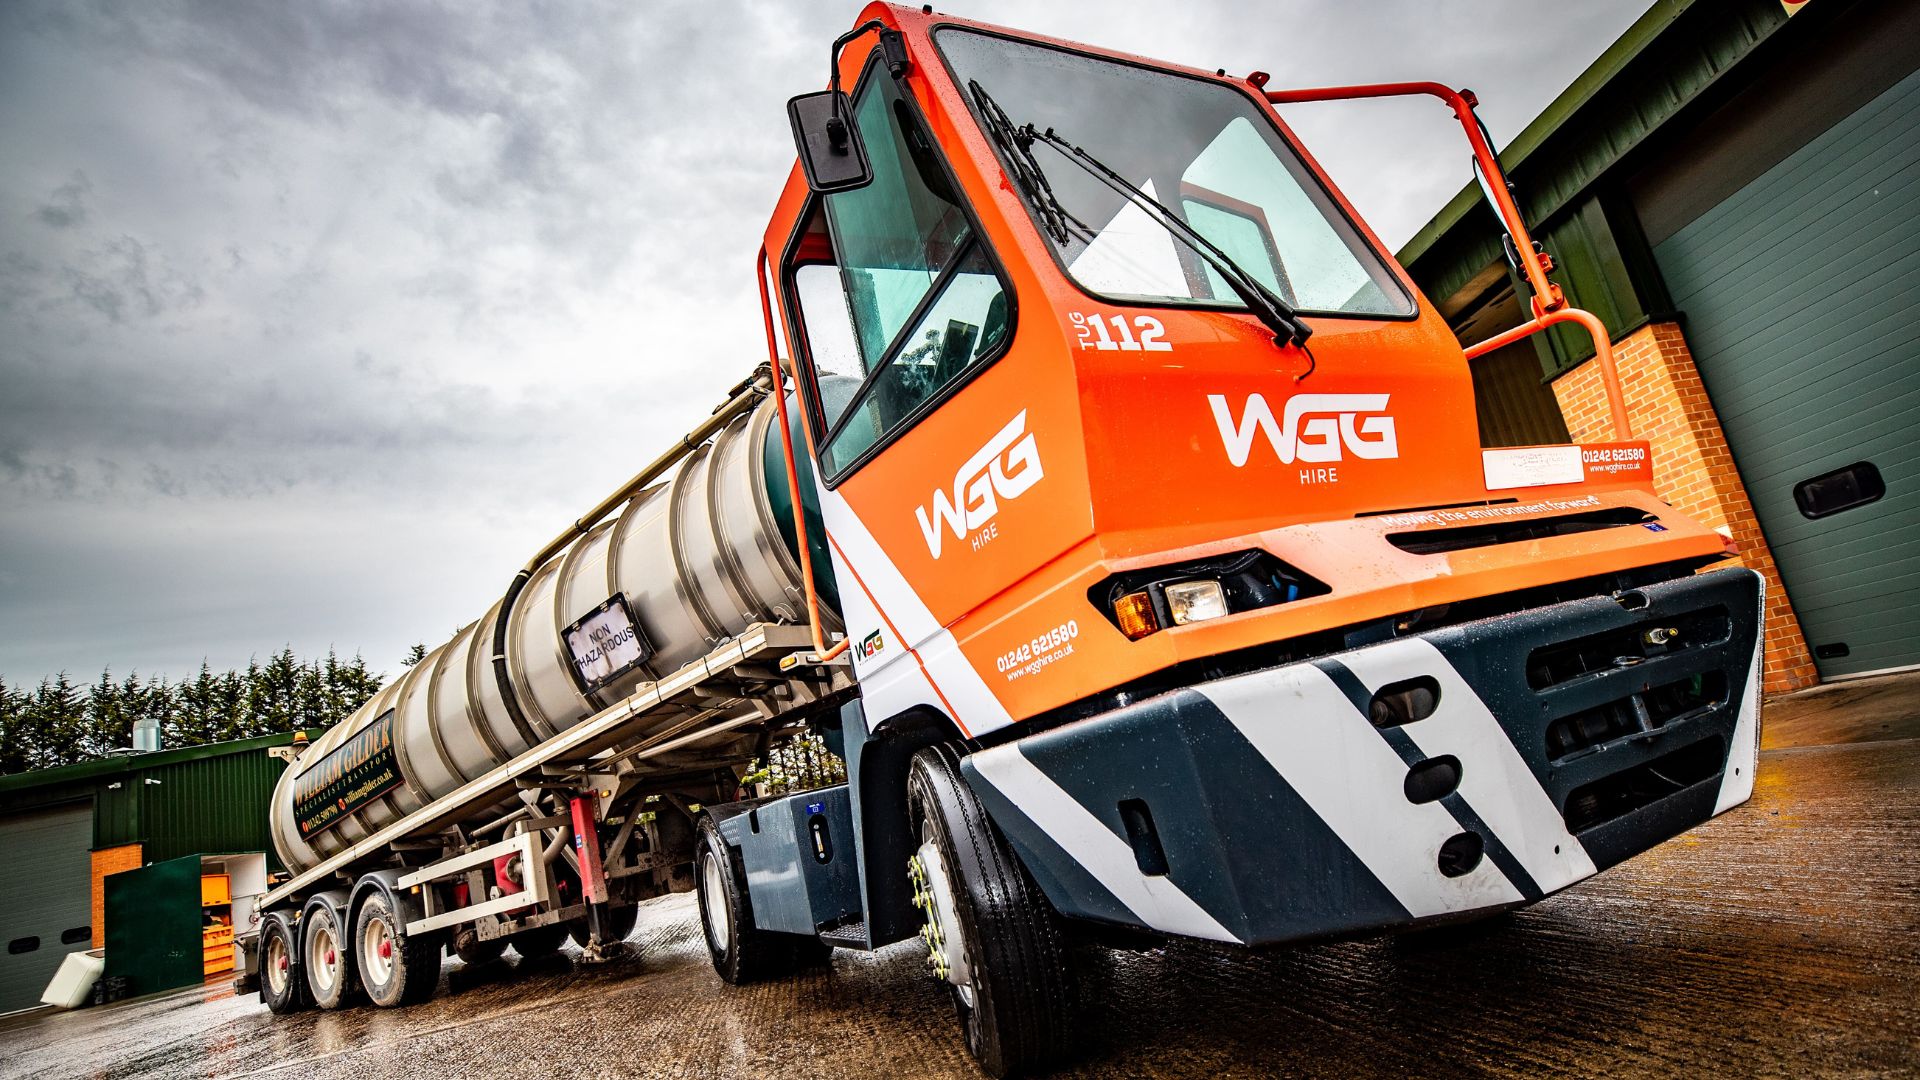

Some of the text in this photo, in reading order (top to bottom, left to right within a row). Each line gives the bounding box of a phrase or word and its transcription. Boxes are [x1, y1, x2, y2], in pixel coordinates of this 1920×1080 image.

[1069, 312, 1095, 350] TUG
[1086, 313, 1173, 351] 112
[1207, 393, 1399, 468] WGG
[1582, 448, 1645, 462] 01242 621580
[1590, 461, 1641, 474] www.wgghire.co.uk
[914, 407, 1044, 560] WGG
[1300, 468, 1339, 485] HIRE
[1379, 513, 1447, 526] Moving
[1437, 510, 1468, 521] the
[1466, 502, 1552, 519] environment
[971, 522, 999, 553] HIRE
[579, 626, 634, 669] HAZARDOUS
[589, 623, 611, 645] NON
[855, 628, 884, 662] WGG
[996, 619, 1079, 673] 01242 621580
[1006, 642, 1074, 682] www.wgghire.co.uk
[294, 719, 391, 807] WILLIAM GILDER
[295, 747, 393, 817] SPECIALIST TRANSPORT
[344, 768, 394, 805] williamgilder.co.uk
[307, 814, 321, 831] 01242
